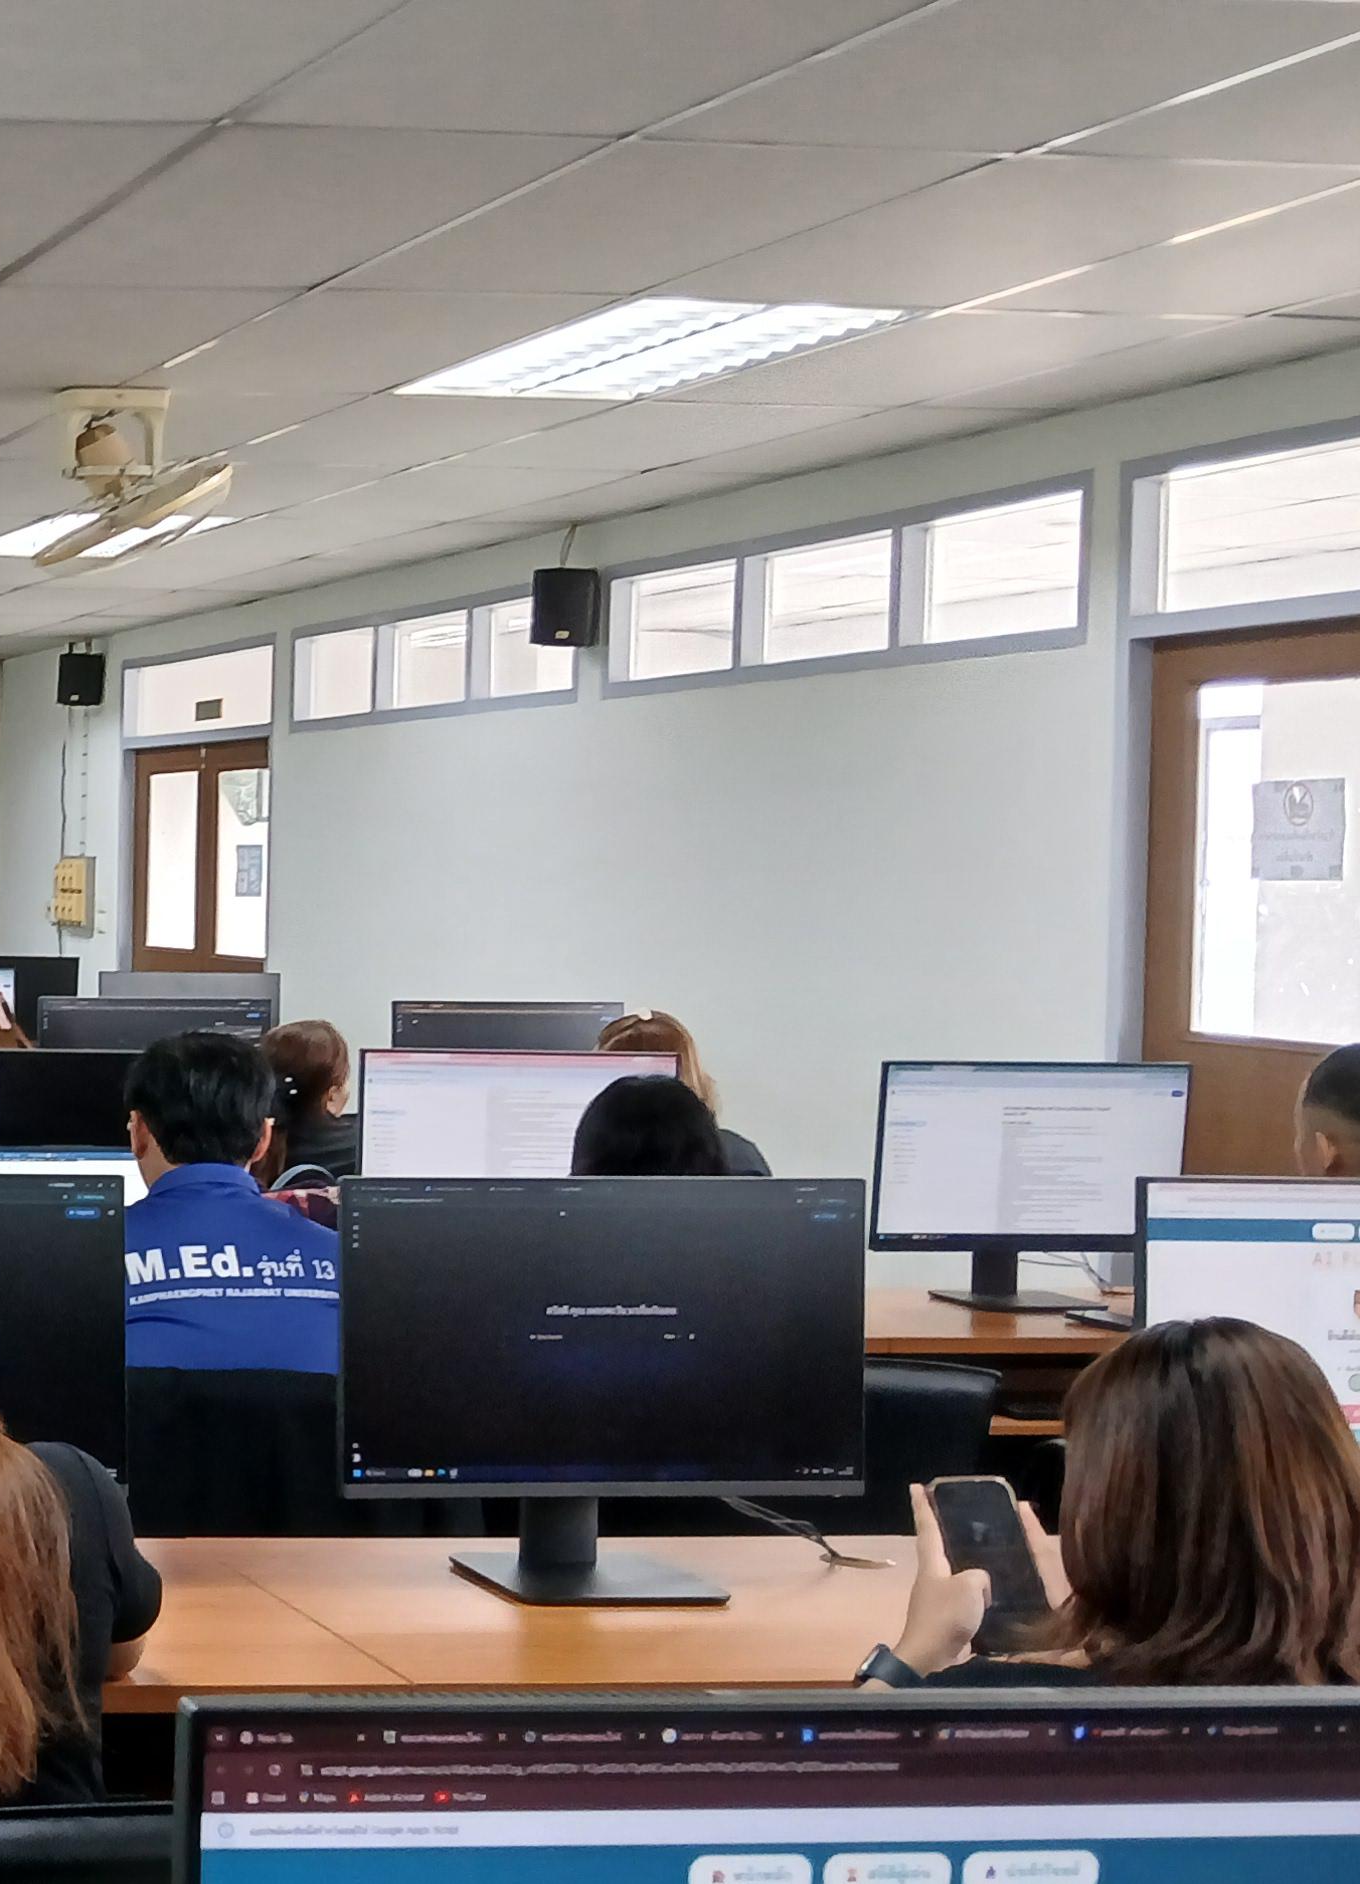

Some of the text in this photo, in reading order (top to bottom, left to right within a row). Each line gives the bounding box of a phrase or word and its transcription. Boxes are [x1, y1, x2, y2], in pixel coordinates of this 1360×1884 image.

[124, 1244, 336, 1287] M.Ed. รุ่นที่ 13
